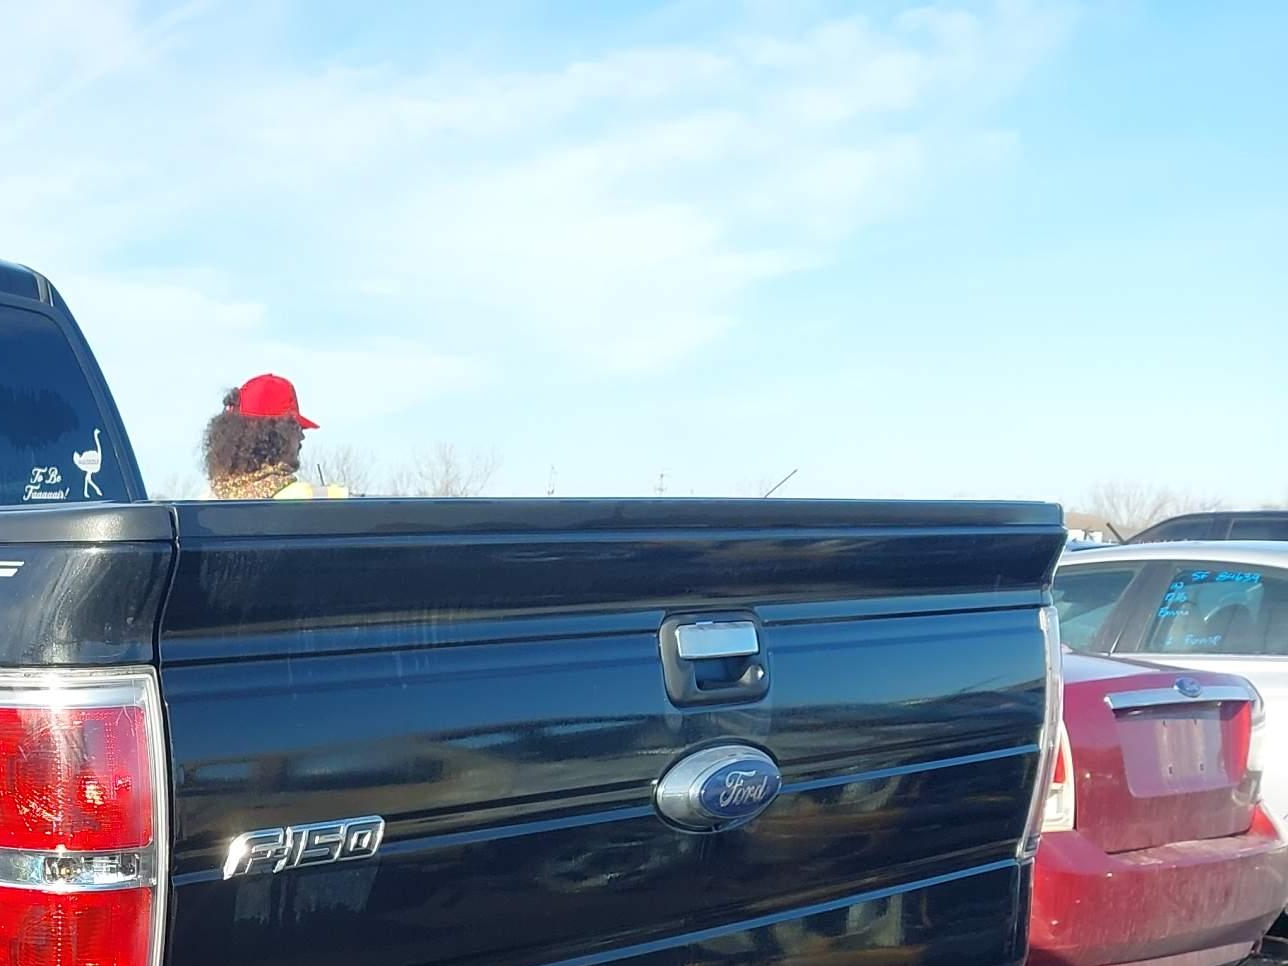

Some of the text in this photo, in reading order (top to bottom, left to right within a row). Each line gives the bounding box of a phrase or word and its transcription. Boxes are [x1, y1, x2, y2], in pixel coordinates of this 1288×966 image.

[30, 467, 62, 483] To Be
[719, 769, 769, 808] Ford
